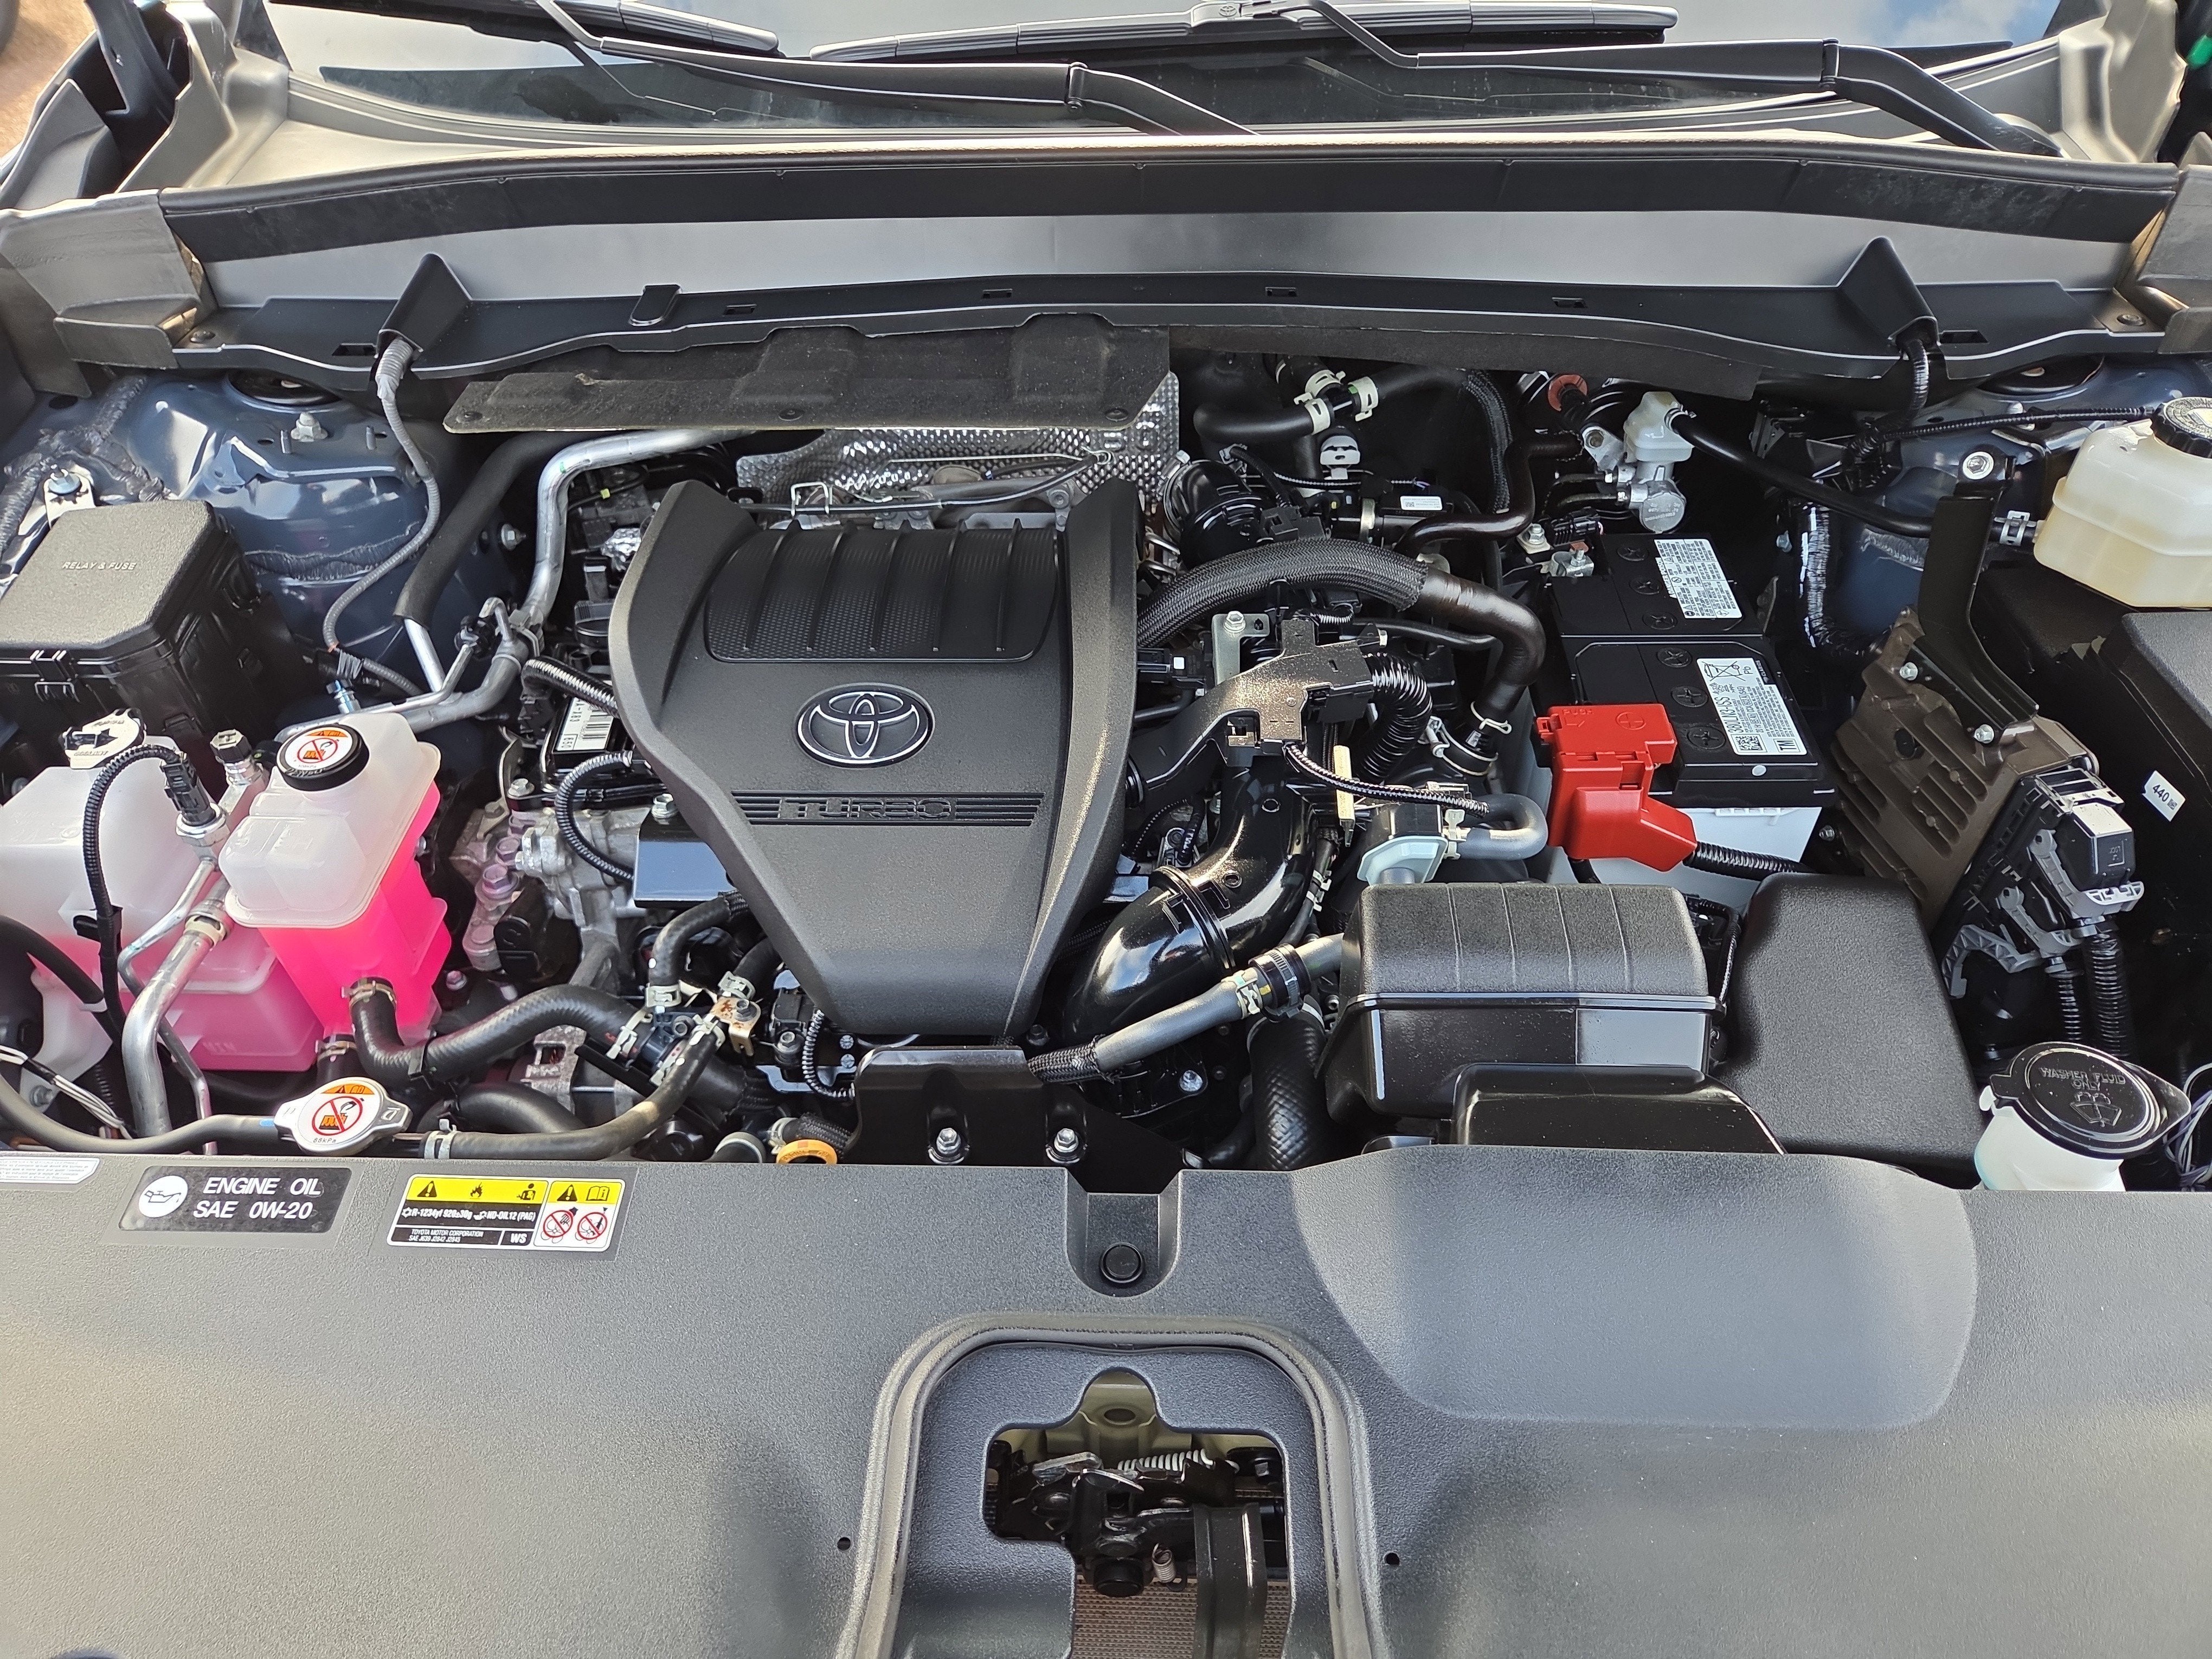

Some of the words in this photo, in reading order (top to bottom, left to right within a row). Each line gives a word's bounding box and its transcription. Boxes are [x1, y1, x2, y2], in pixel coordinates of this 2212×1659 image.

[61, 561, 98, 569] RELAY
[98, 561, 106, 570] &
[108, 562, 137, 570] FUSE
[1742, 666, 1753, 674] Pb
[1714, 697, 1744, 733] 380LN3-ISS
[1776, 740, 1797, 751] TM
[2152, 784, 2170, 802] 440
[786, 796, 951, 819] TURBO
[2039, 1067, 2088, 1081] WASHER
[2092, 1073, 2126, 1085] FLUID
[2072, 1079, 2101, 1091] ONLY
[203, 1177, 281, 1194] ENGINE
[290, 1178, 322, 1195] OIL
[193, 1200, 239, 1218] SAE
[249, 1201, 313, 1219] 0W-20
[517, 1212, 536, 1221] (PAG)
[510, 1233, 528, 1244] WS
